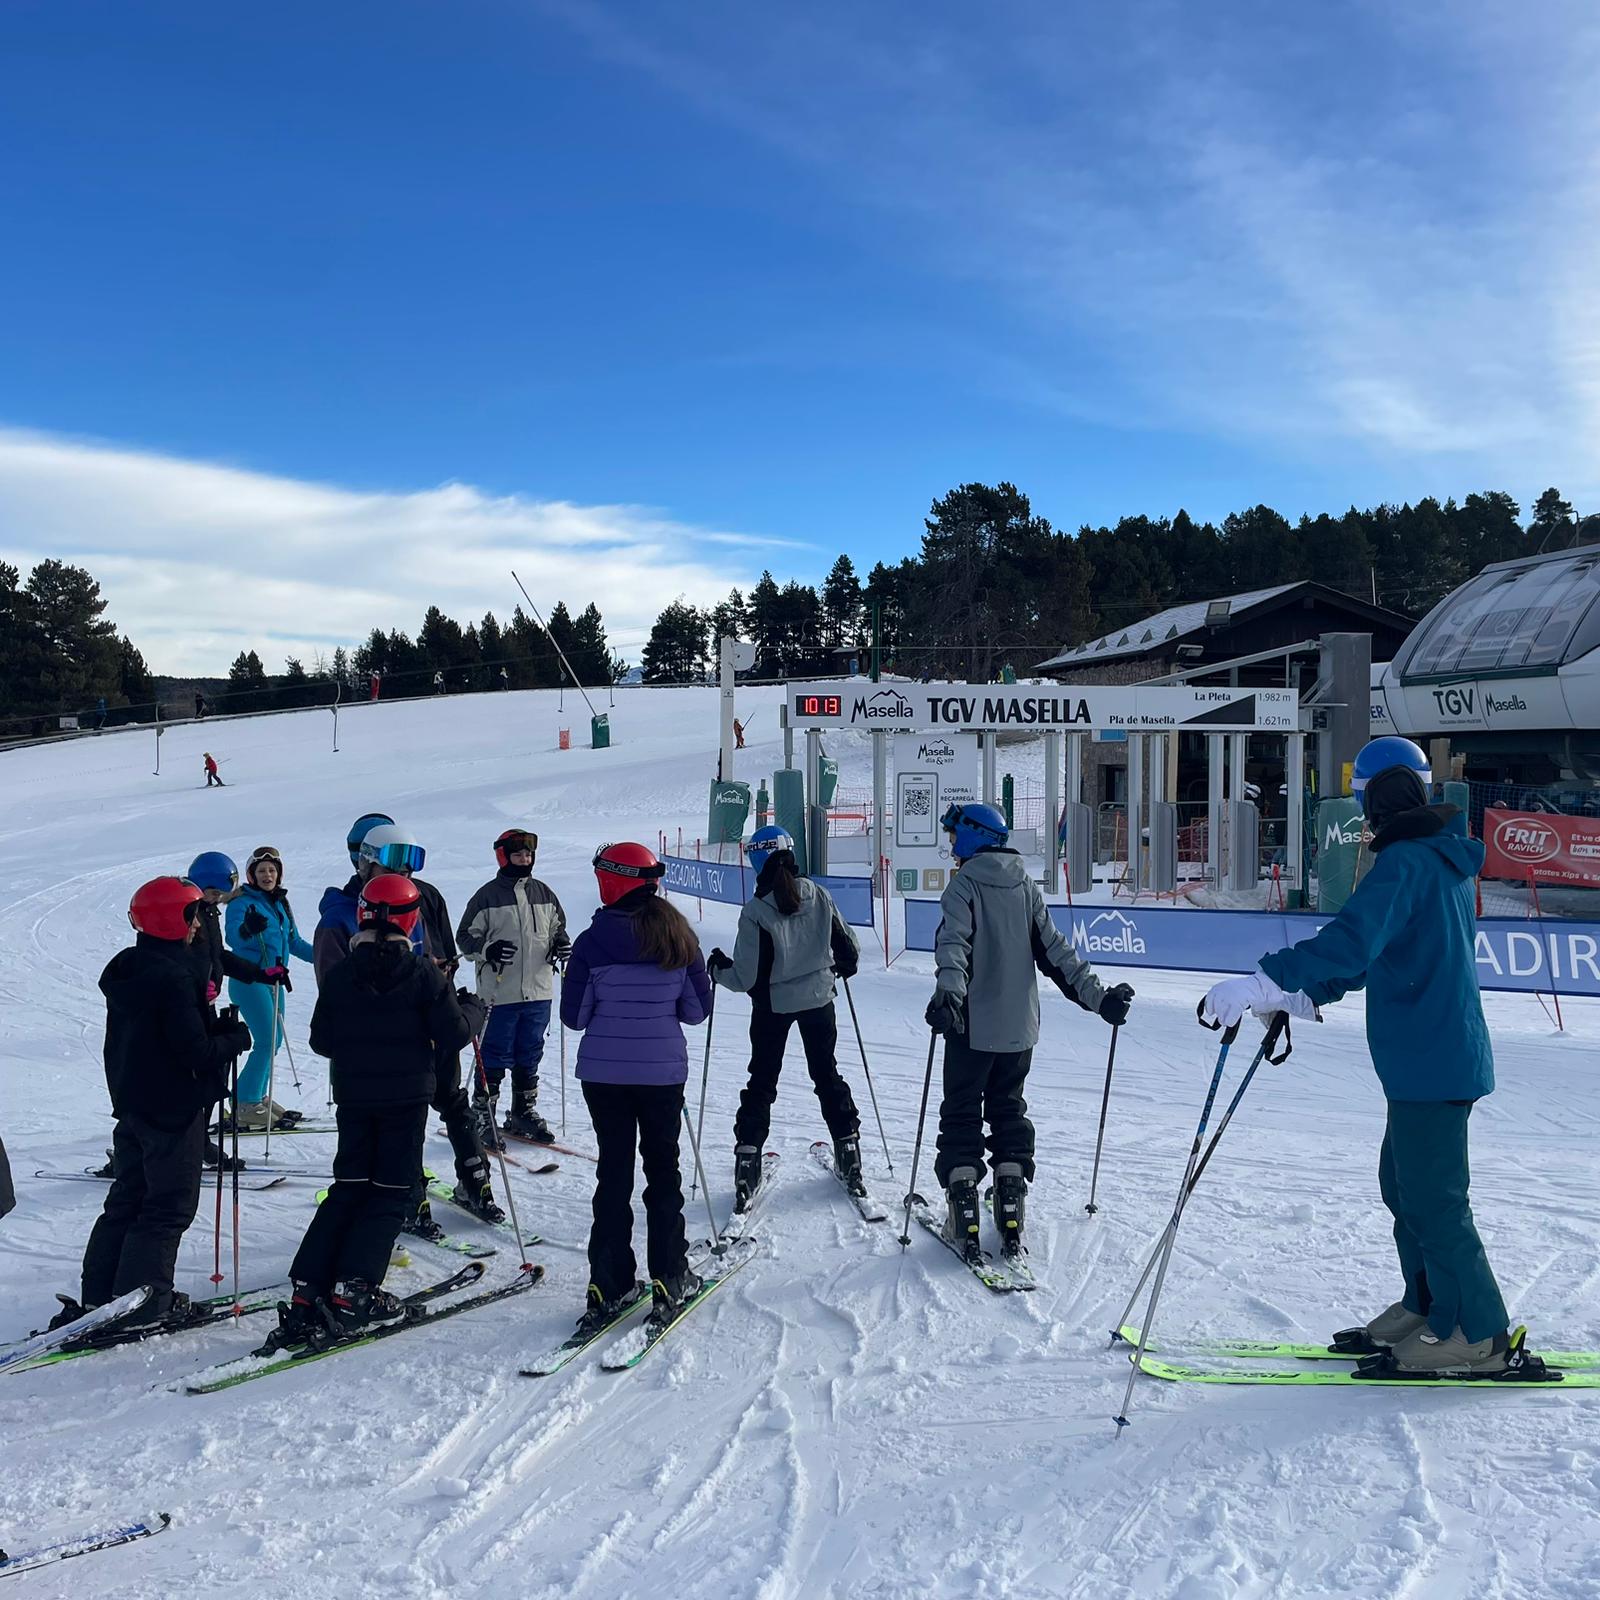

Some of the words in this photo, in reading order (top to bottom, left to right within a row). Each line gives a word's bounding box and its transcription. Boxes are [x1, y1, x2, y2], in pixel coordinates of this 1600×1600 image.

[1195, 692, 1204, 701] La
[1208, 692, 1231, 701] Pleta
[1258, 692, 1280, 701] 1.982
[1433, 688, 1474, 716] TGV
[1486, 693, 1527, 716] Masella
[851, 696, 914, 723] Masella
[927, 698, 976, 723] TGV
[982, 698, 1092, 723] MASELLA
[1109, 715, 1123, 724] Pla
[1127, 715, 1138, 724] de
[1141, 715, 1175, 724] Masella
[917, 744, 955, 759] Masella
[715, 793, 744, 805] Masella
[1324, 821, 1376, 850] Mase
[1504, 827, 1551, 846] FRIT
[1507, 843, 1544, 853] RAVICH
[663, 861, 702, 890] ELECADIRA
[707, 869, 724, 894] TGV
[1072, 918, 1146, 954] Masella
